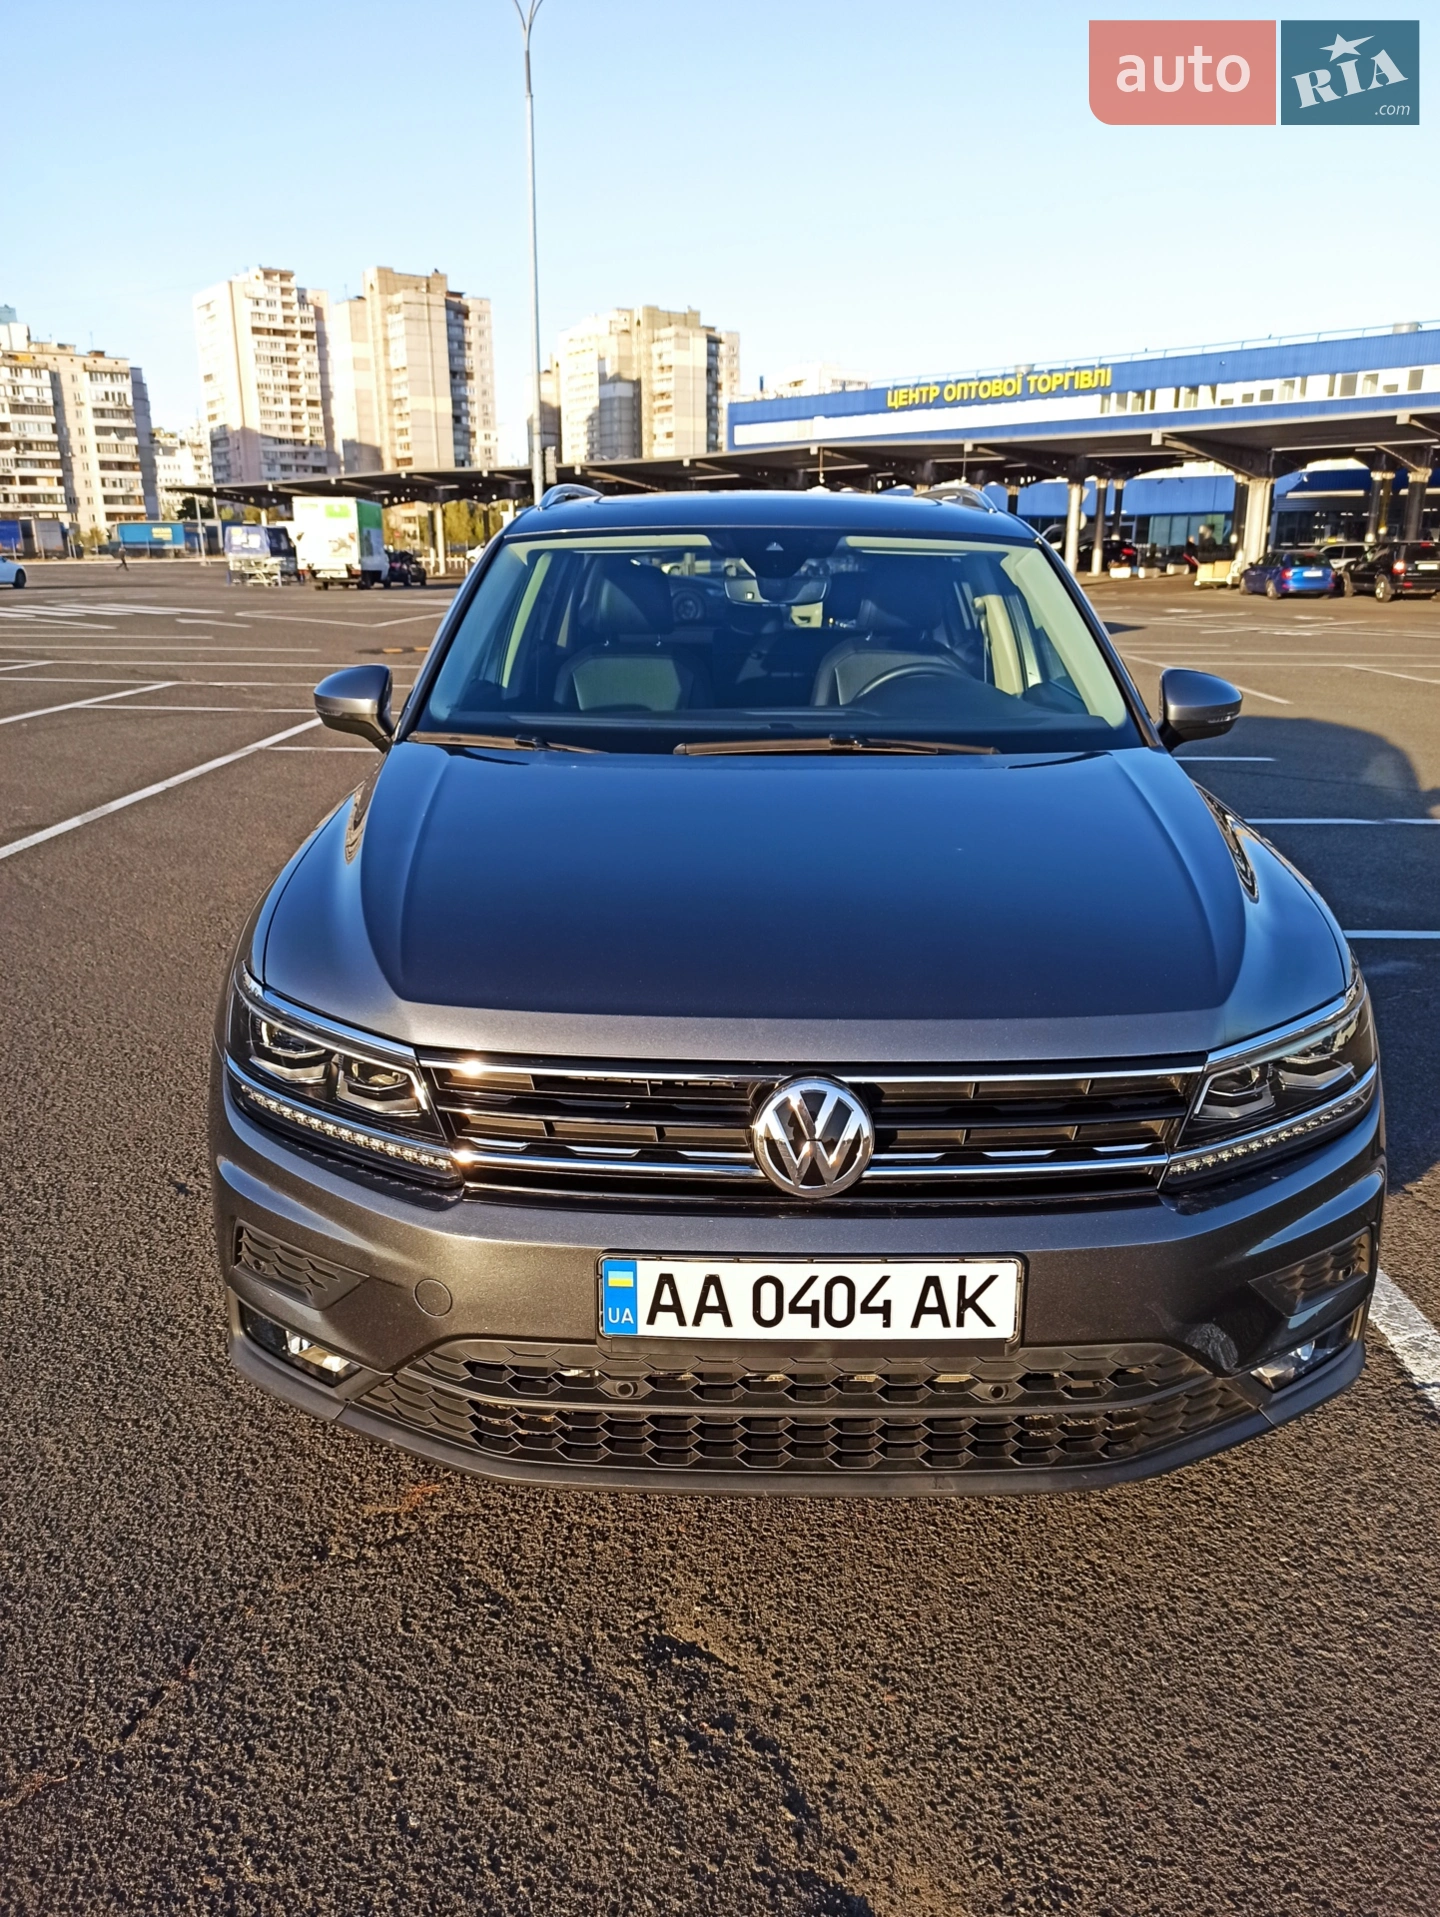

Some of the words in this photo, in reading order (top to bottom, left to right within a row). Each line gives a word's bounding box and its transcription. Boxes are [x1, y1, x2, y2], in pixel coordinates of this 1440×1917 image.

[887, 384, 940, 409] ЦЕНТР
[943, 374, 1023, 402] ОПТОВОЇ
[1027, 367, 1112, 394] ТОРГІВЛІ
[607, 1307, 635, 1325] UA
[645, 1272, 734, 1328] AA
[751, 1273, 893, 1329] 0404
[910, 1273, 1000, 1329] AK
